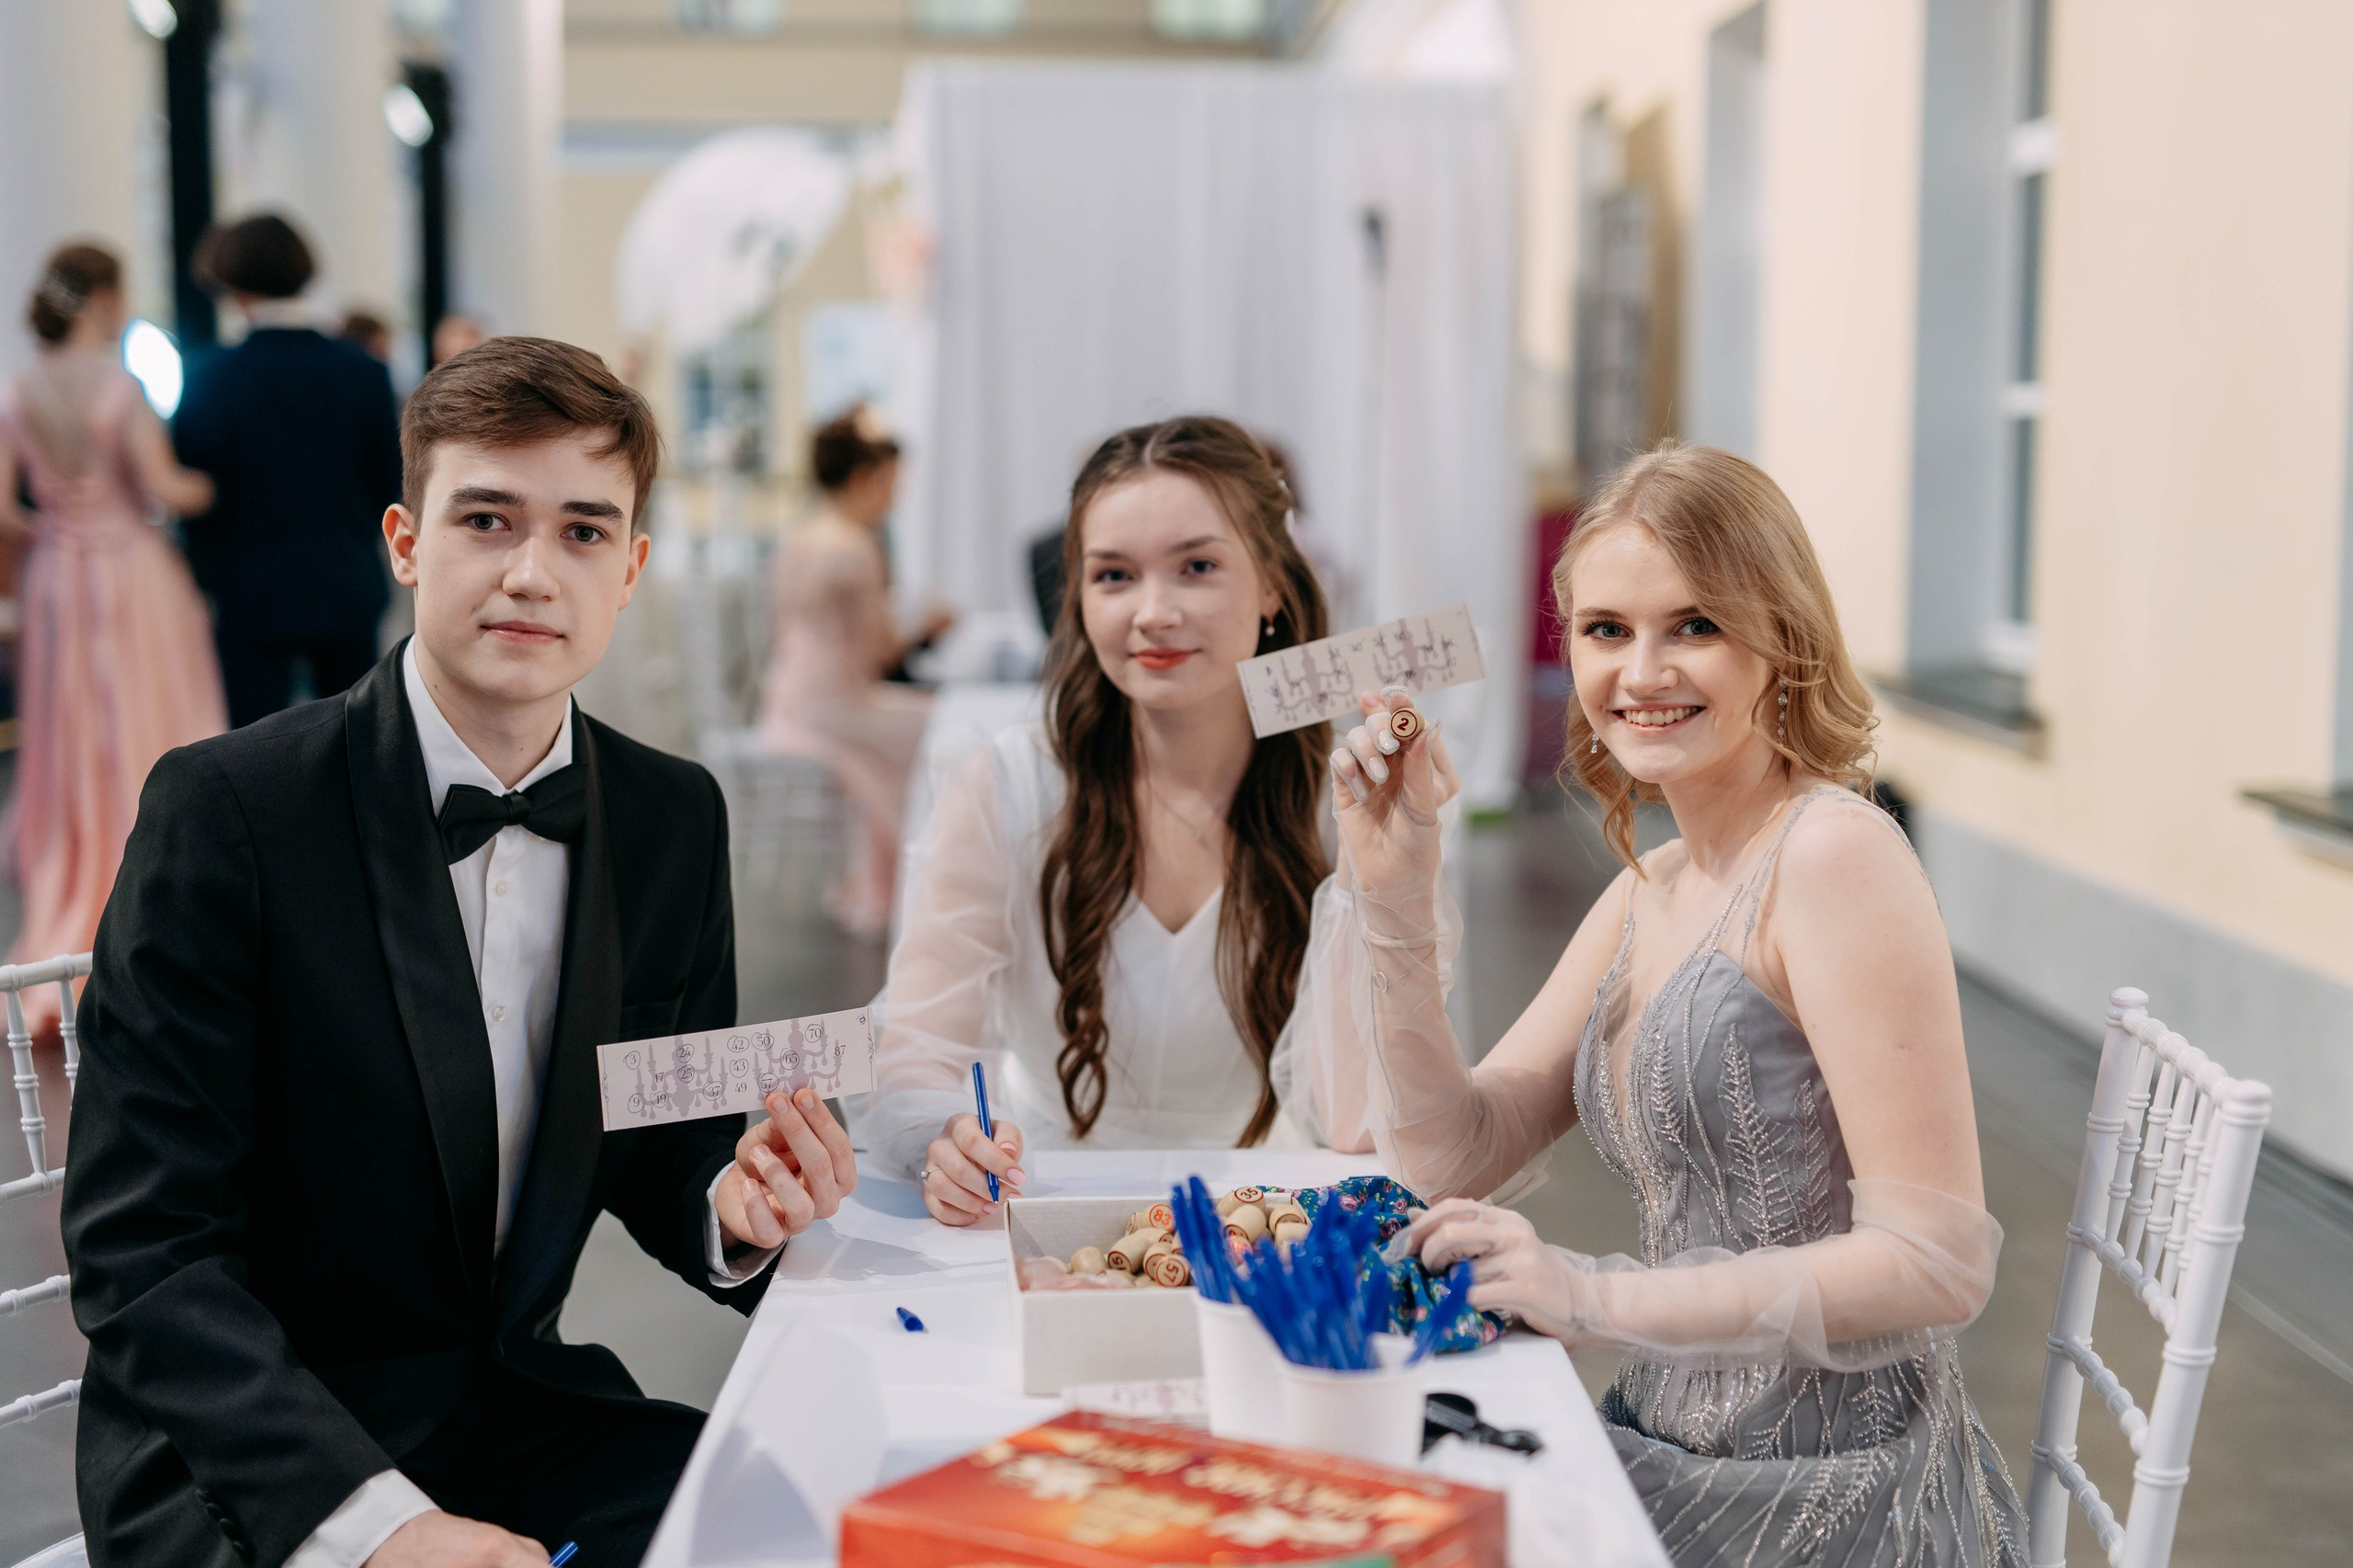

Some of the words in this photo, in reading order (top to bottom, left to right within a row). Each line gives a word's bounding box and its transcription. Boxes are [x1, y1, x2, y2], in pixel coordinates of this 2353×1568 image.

[1396, 717, 1409, 732] 2
[808, 1028, 822, 1040] 70
[731, 1040, 745, 1051] 42
[756, 1035, 771, 1048] 50
[678, 1047, 691, 1059] 24
[834, 1044, 847, 1057] 87
[630, 1054, 637, 1065] 3
[784, 1052, 798, 1064] 65
[733, 1061, 745, 1072] 43
[654, 1072, 665, 1084] 17
[680, 1068, 693, 1080] 25
[734, 1082, 747, 1093] 49
[760, 1078, 773, 1089] 57
[709, 1085, 721, 1097] 37
[632, 1096, 641, 1108] 9
[655, 1093, 667, 1105] 19
[1240, 1187, 1258, 1199] 35
[1154, 1209, 1172, 1226] 83
[1164, 1262, 1179, 1283] 57
